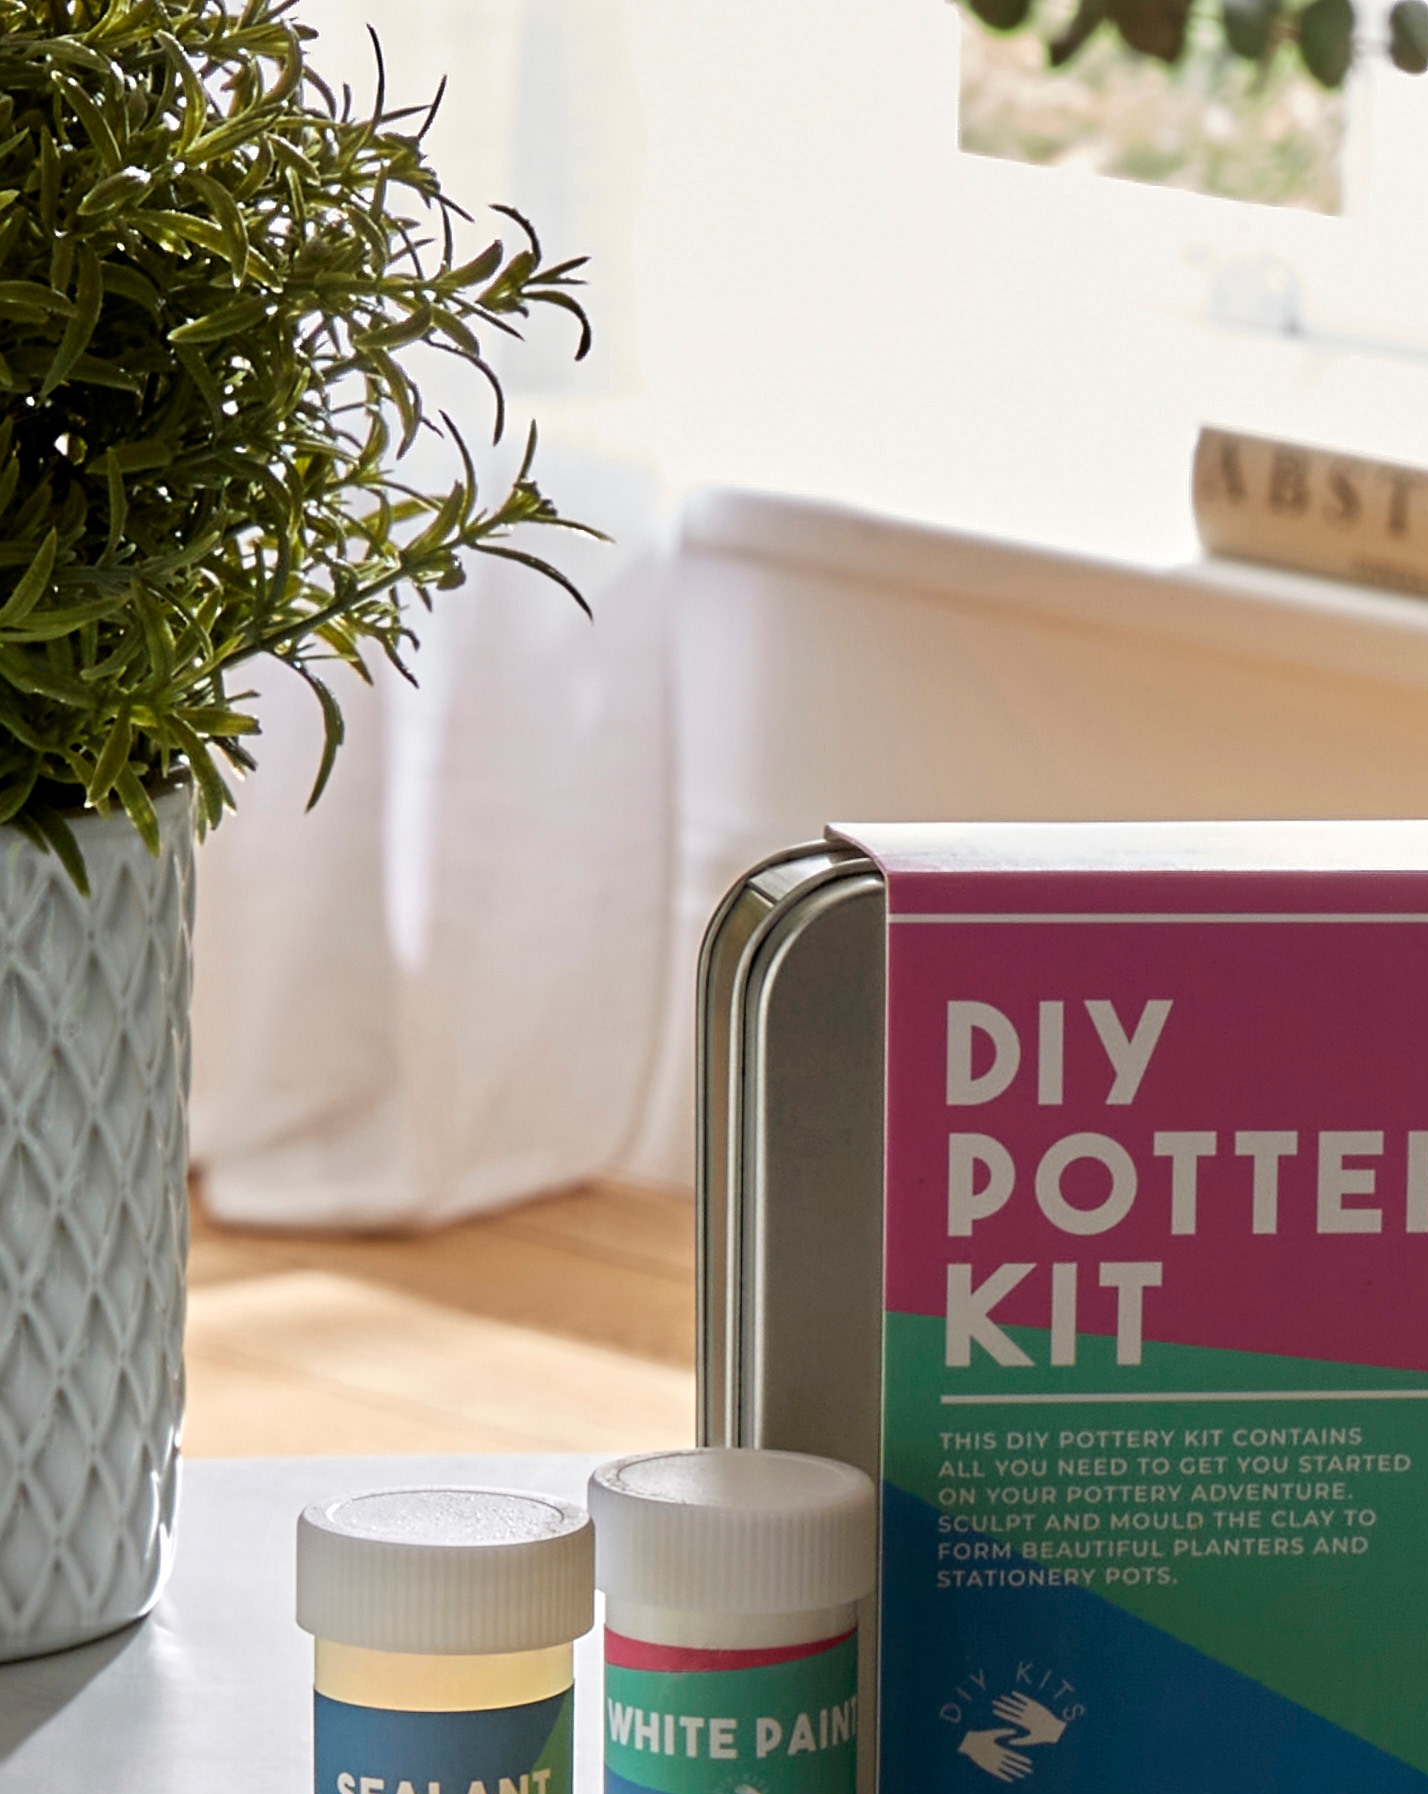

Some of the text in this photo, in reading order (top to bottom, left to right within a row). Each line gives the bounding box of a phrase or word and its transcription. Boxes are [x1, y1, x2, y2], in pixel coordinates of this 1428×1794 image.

[945, 999, 1174, 1106] DIY
[945, 1261, 1163, 1368] KIT
[939, 1428, 1363, 1450] THIS DIY POTTERY KIT CONTAINS
[938, 1454, 1412, 1478] ALL YOU NEED TO GET YOU STARTED
[938, 1482, 1353, 1505] ON YOUR POTTERY ADVENTURE.
[938, 1509, 1377, 1533] SCULPT AND MOULD THE CLAY TO
[938, 1536, 1369, 1561] FORM BEAUTIFUL PLANTERS AND
[937, 1566, 1178, 1589] STATIONERY POTS.
[939, 1660, 1086, 1724] DIY KITS
[607, 1696, 738, 1760] WHITE
